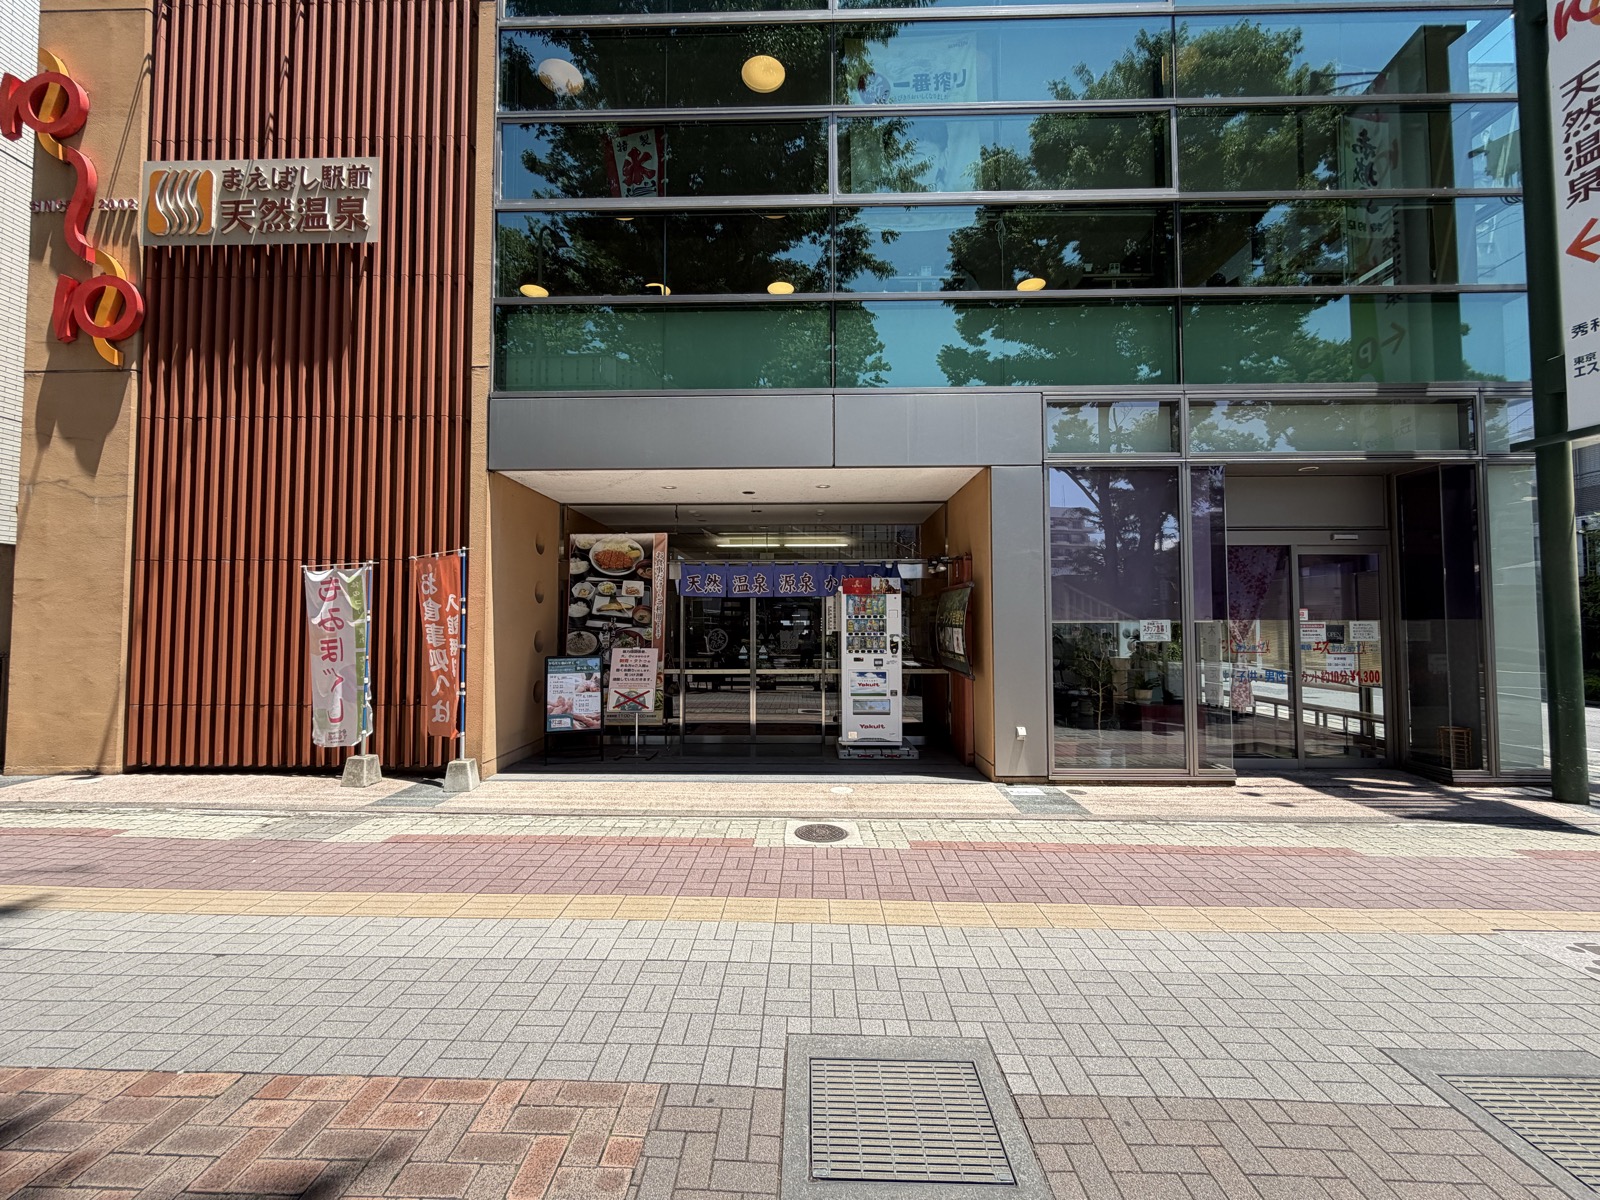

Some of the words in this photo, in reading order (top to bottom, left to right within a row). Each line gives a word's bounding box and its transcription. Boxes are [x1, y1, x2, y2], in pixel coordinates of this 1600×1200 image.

[893, 69, 967, 92] 一番搾り
[1559, 59, 1600, 210] 天然温泉
[623, 147, 656, 186] 氷
[221, 164, 373, 192] まえばし駅前
[30, 199, 68, 213] SINC
[98, 198, 138, 211] 2002
[220, 195, 371, 235] 天然温泉
[1573, 351, 1597, 366] 東京
[1573, 361, 1600, 379] エス
[686, 573, 722, 593] 天然
[732, 573, 769, 594] 温泉
[779, 573, 816, 594] 源泉
[1312, 641, 1331, 655] エス
